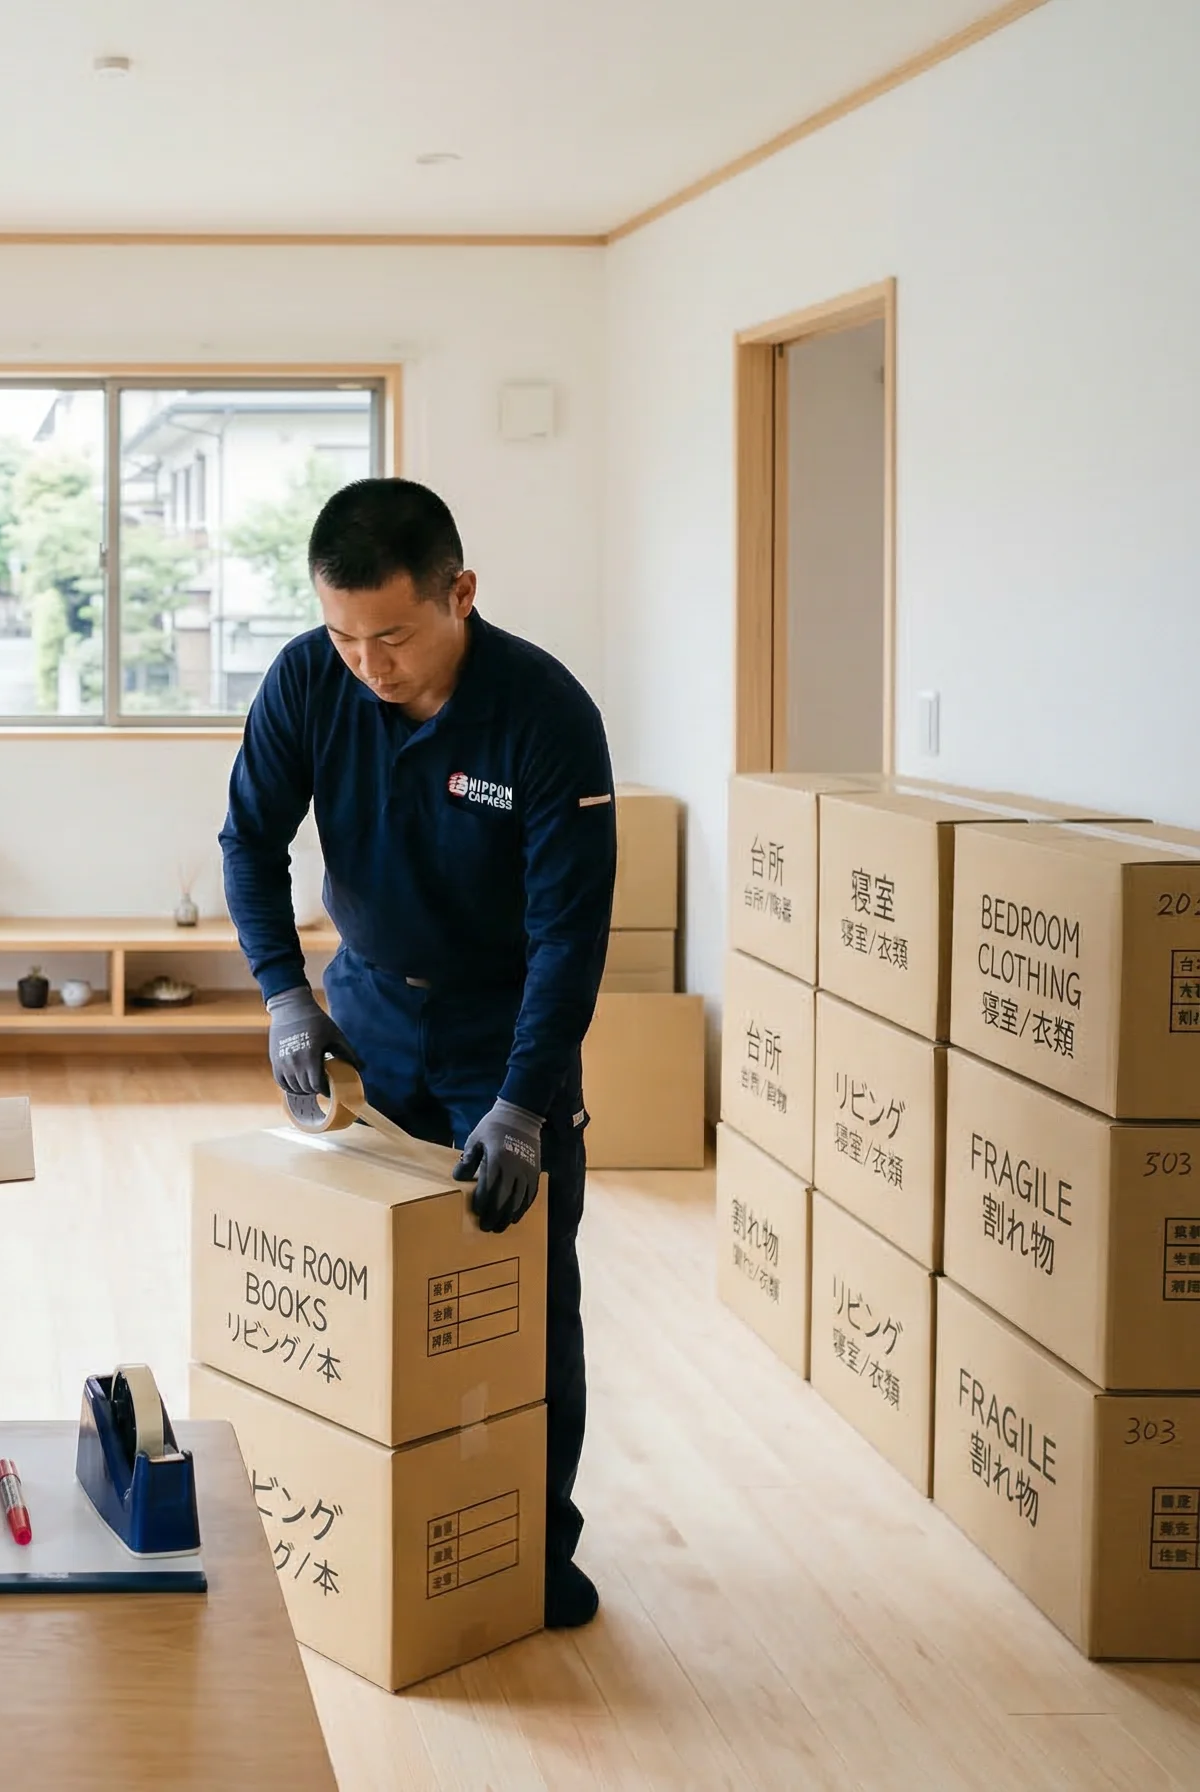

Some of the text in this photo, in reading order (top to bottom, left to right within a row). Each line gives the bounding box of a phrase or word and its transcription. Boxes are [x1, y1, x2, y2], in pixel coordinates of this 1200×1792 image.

[469, 777, 513, 801] NIPPON
[751, 833, 784, 887] 台所
[850, 867, 896, 923] 寝室
[981, 894, 1080, 958] BEDROOM
[978, 943, 1082, 1010] CLOTHING
[747, 1020, 782, 1075] 台所
[981, 990, 1075, 1059] 寝室/衣類
[836, 1072, 906, 1139] リビング
[971, 1132, 1072, 1226] FRAGILE
[213, 1213, 368, 1301] LIVING ROOM
[982, 1192, 1055, 1276] 割れ物
[245, 1271, 327, 1332] BOOKS
[833, 1273, 904, 1355] リビング
[228, 1312, 342, 1383] リビング/本
[959, 1367, 1056, 1485] FRAGILE
[1124, 1417, 1176, 1445] 303
[969, 1430, 1038, 1528] 割れ物
